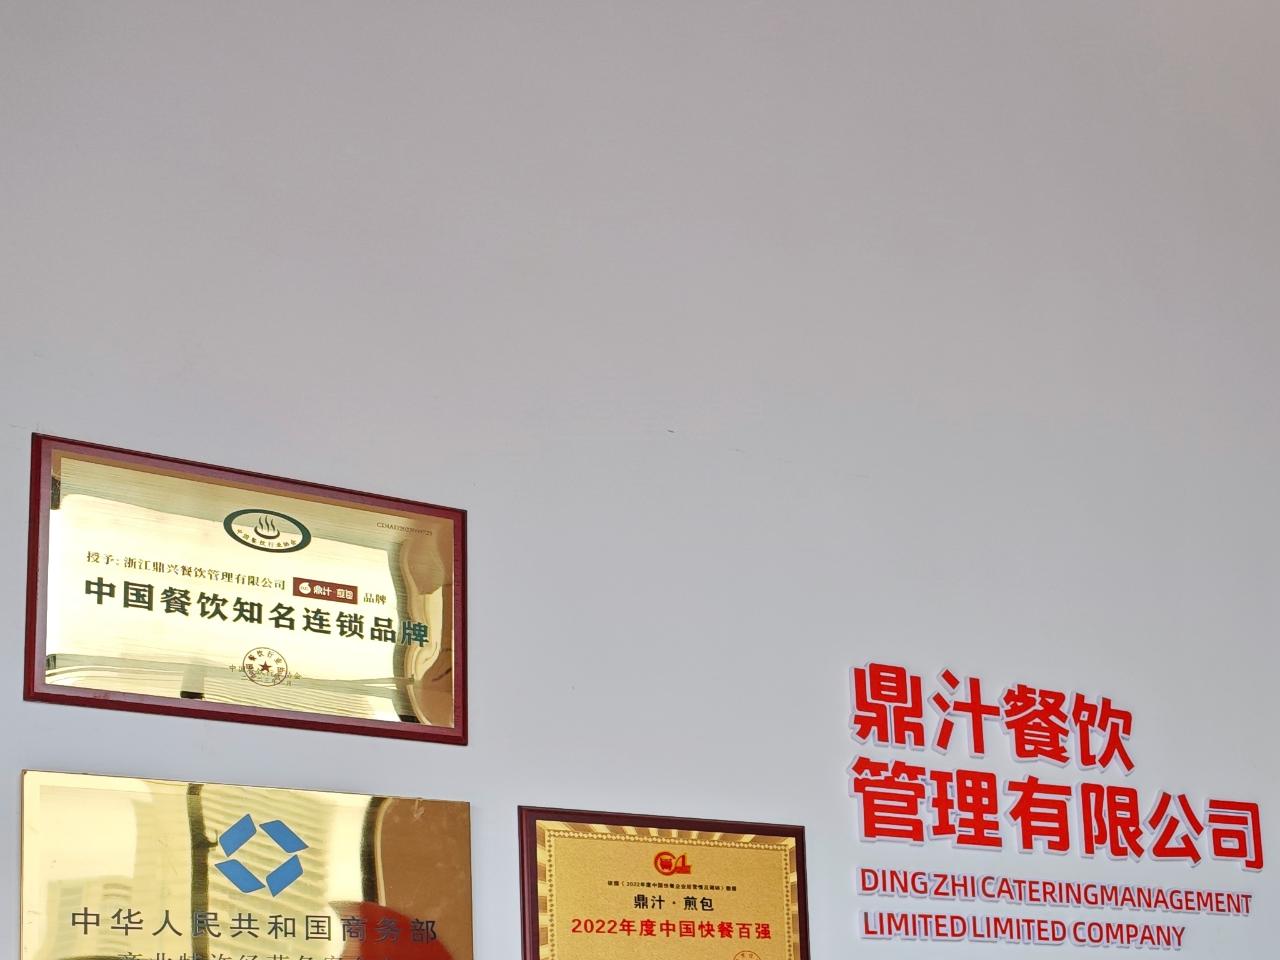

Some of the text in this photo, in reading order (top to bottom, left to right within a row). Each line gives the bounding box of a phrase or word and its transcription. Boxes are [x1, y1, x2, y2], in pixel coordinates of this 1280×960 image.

[84, 576, 430, 648] 中国餐饮知名连锁品牌
[853, 662, 1135, 774] 鼎汁餐饮
[852, 756, 1264, 870] 管理有限公司
[70, 906, 437, 945] 中华人民共和国商务部
[571, 918, 772, 940] 2022年度中国快餐百强
[1072, 921, 1186, 947] COMPANY
